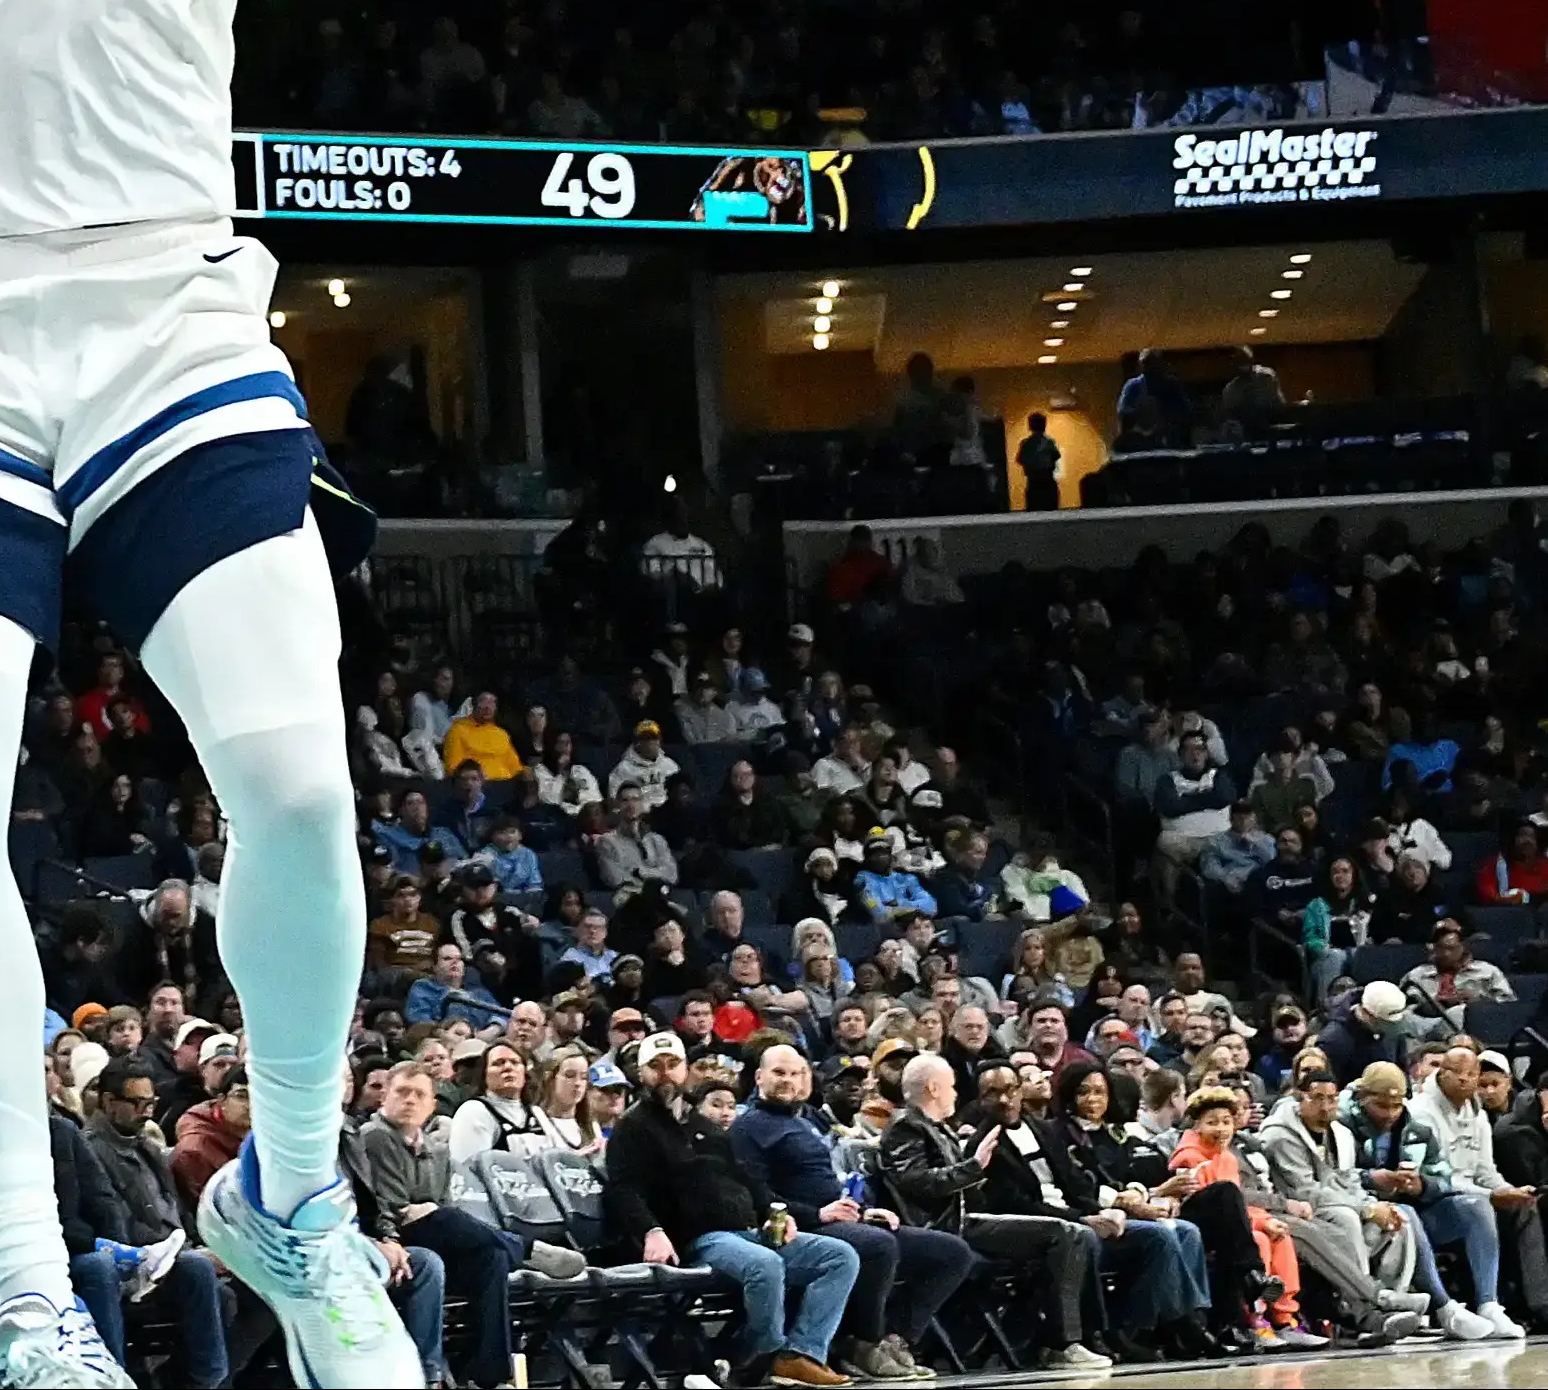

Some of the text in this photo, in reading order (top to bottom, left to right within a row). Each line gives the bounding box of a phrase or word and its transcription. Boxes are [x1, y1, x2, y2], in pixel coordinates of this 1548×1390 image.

[273, 144, 462, 178] TIMEOUTS: 4
[1173, 128, 1373, 169] SealMaster
[275, 179, 411, 210] FOULS: 0
[540, 152, 636, 219] 49
